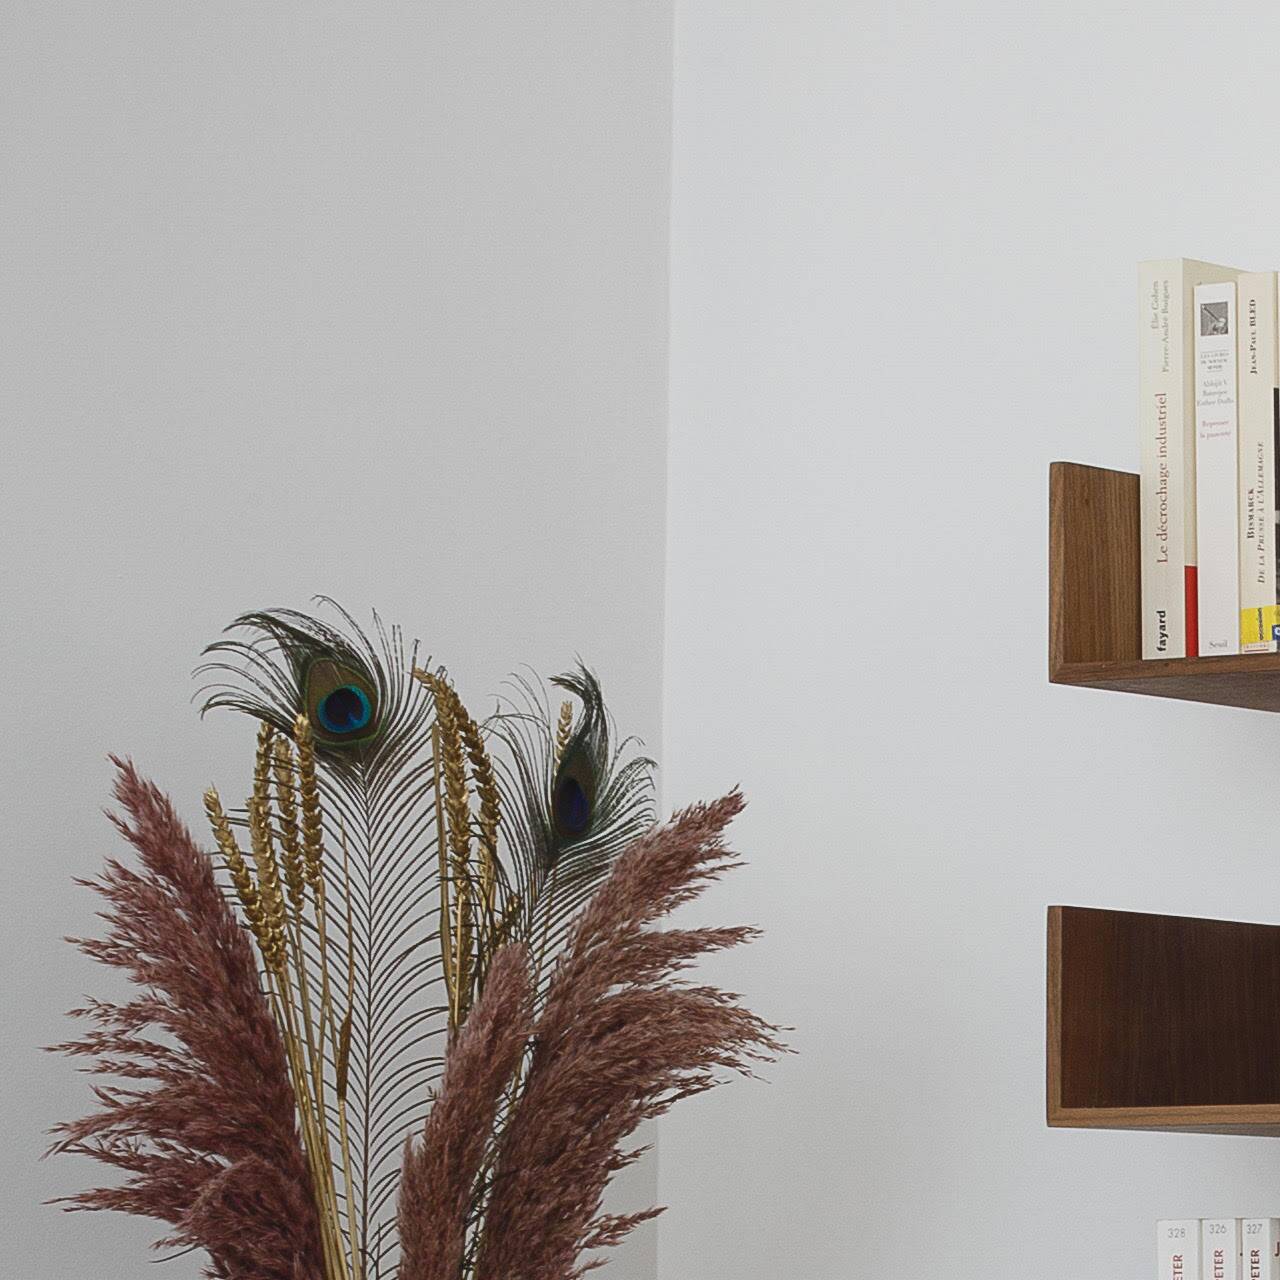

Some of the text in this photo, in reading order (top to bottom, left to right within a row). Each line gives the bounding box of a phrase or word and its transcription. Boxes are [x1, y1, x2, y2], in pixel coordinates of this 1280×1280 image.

[1155, 393, 1169, 563] Le décrochage industriel
[1247, 488, 1255, 539] BISMARCK
[1157, 610, 1168, 652] fayard
